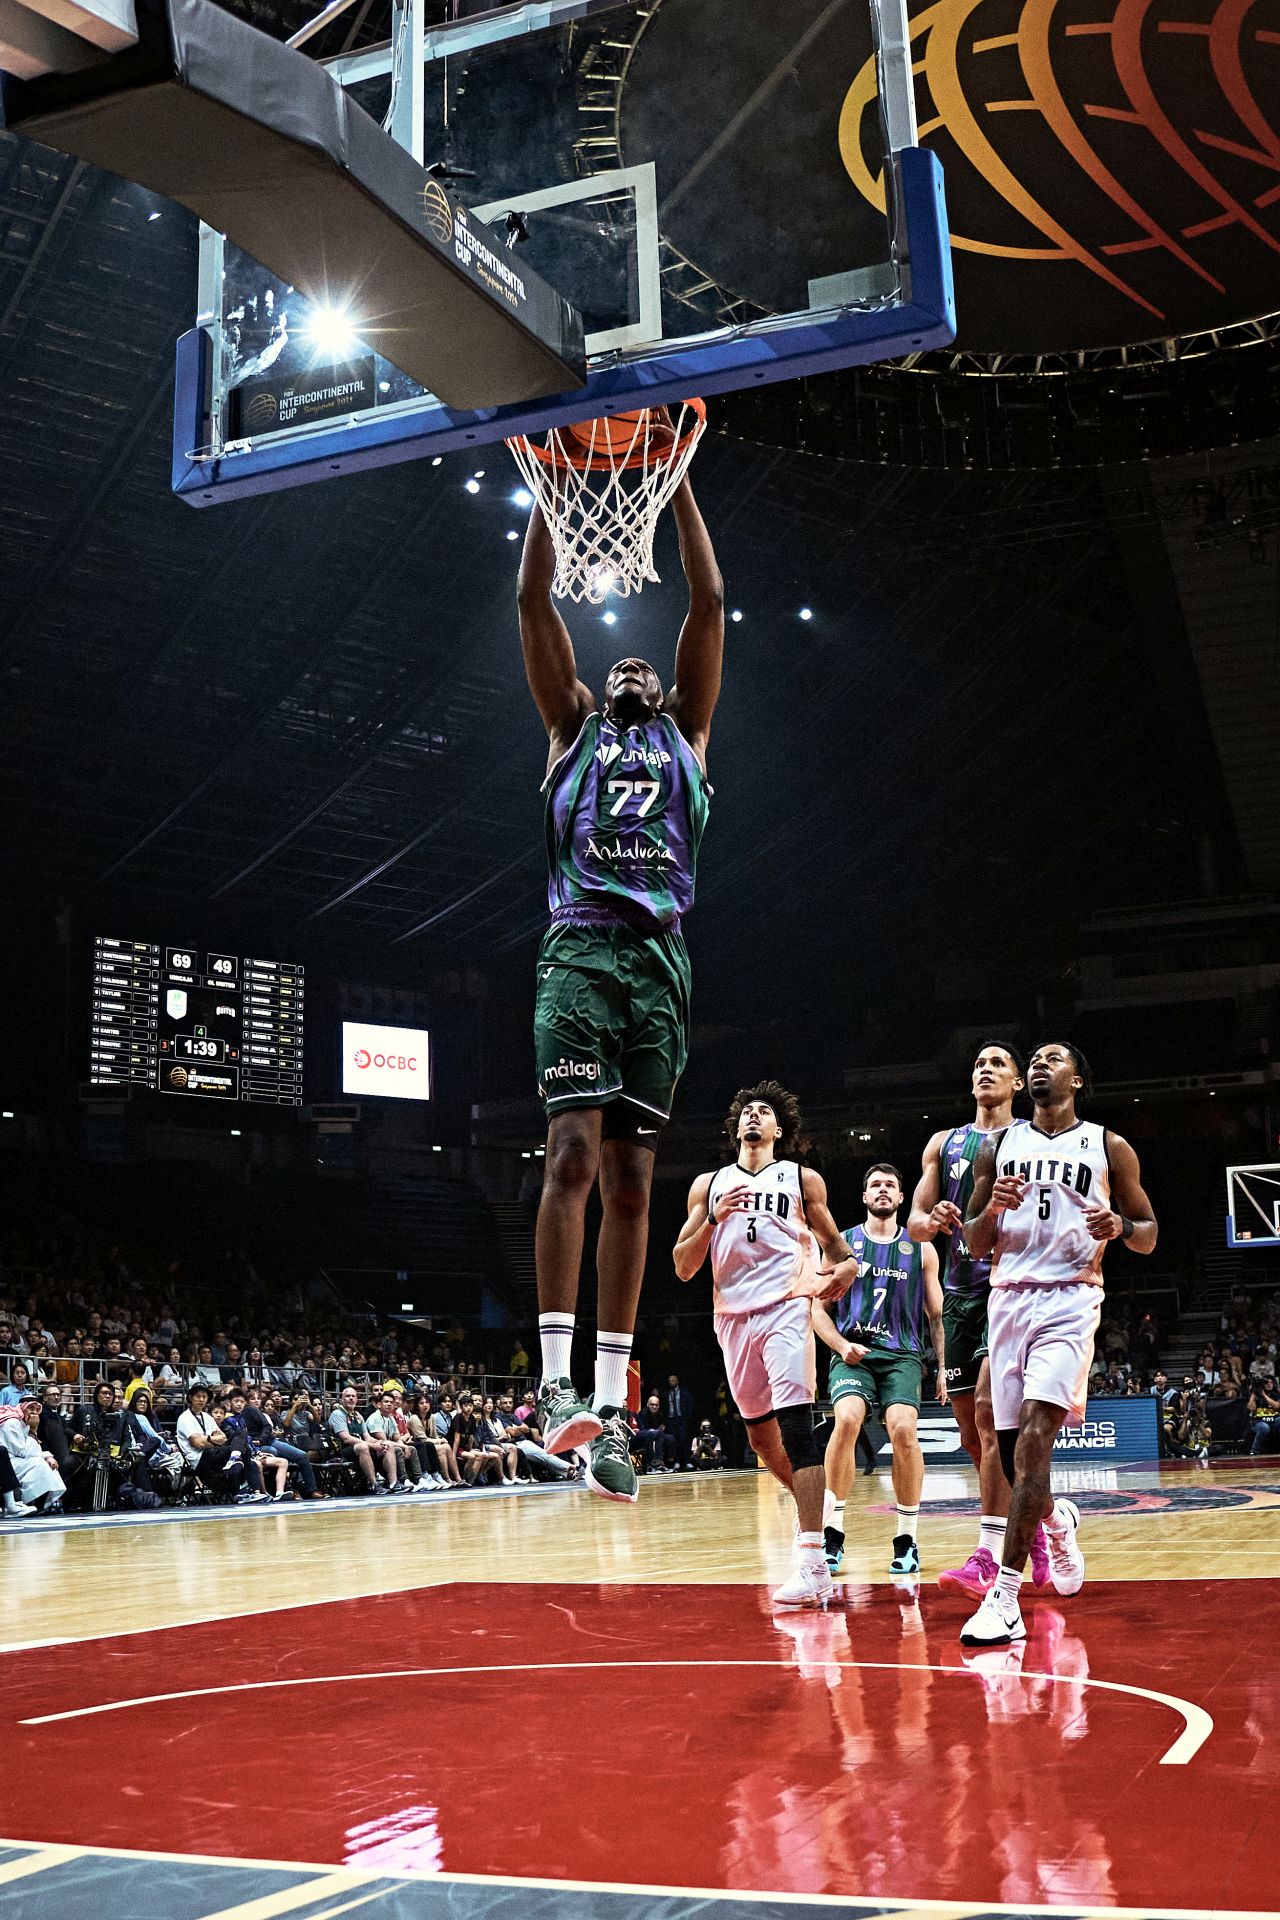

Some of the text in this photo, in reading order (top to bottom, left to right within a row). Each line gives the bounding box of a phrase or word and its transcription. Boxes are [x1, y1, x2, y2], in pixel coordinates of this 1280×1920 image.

[455, 241, 472, 267] CUP
[455, 219, 527, 300] INTERCONTINENTAL
[280, 380, 366, 410] INTERCONTINENTAL
[280, 408, 297, 421] CUP
[608, 780, 660, 817] 77
[172, 953, 191, 969] 69
[213, 959, 232, 974] 49
[197, 1027, 204, 1036] 4
[162, 1041, 168, 1049] 3
[184, 1039, 218, 1056] 1:39
[373, 1053, 417, 1071] OCBC
[1003, 1160, 1092, 1198] UNITED
[1038, 1188, 1052, 1221] 5
[746, 1217, 757, 1243] 3
[873, 1287, 887, 1311] 7
[1052, 1437, 1117, 1449] MANCE
